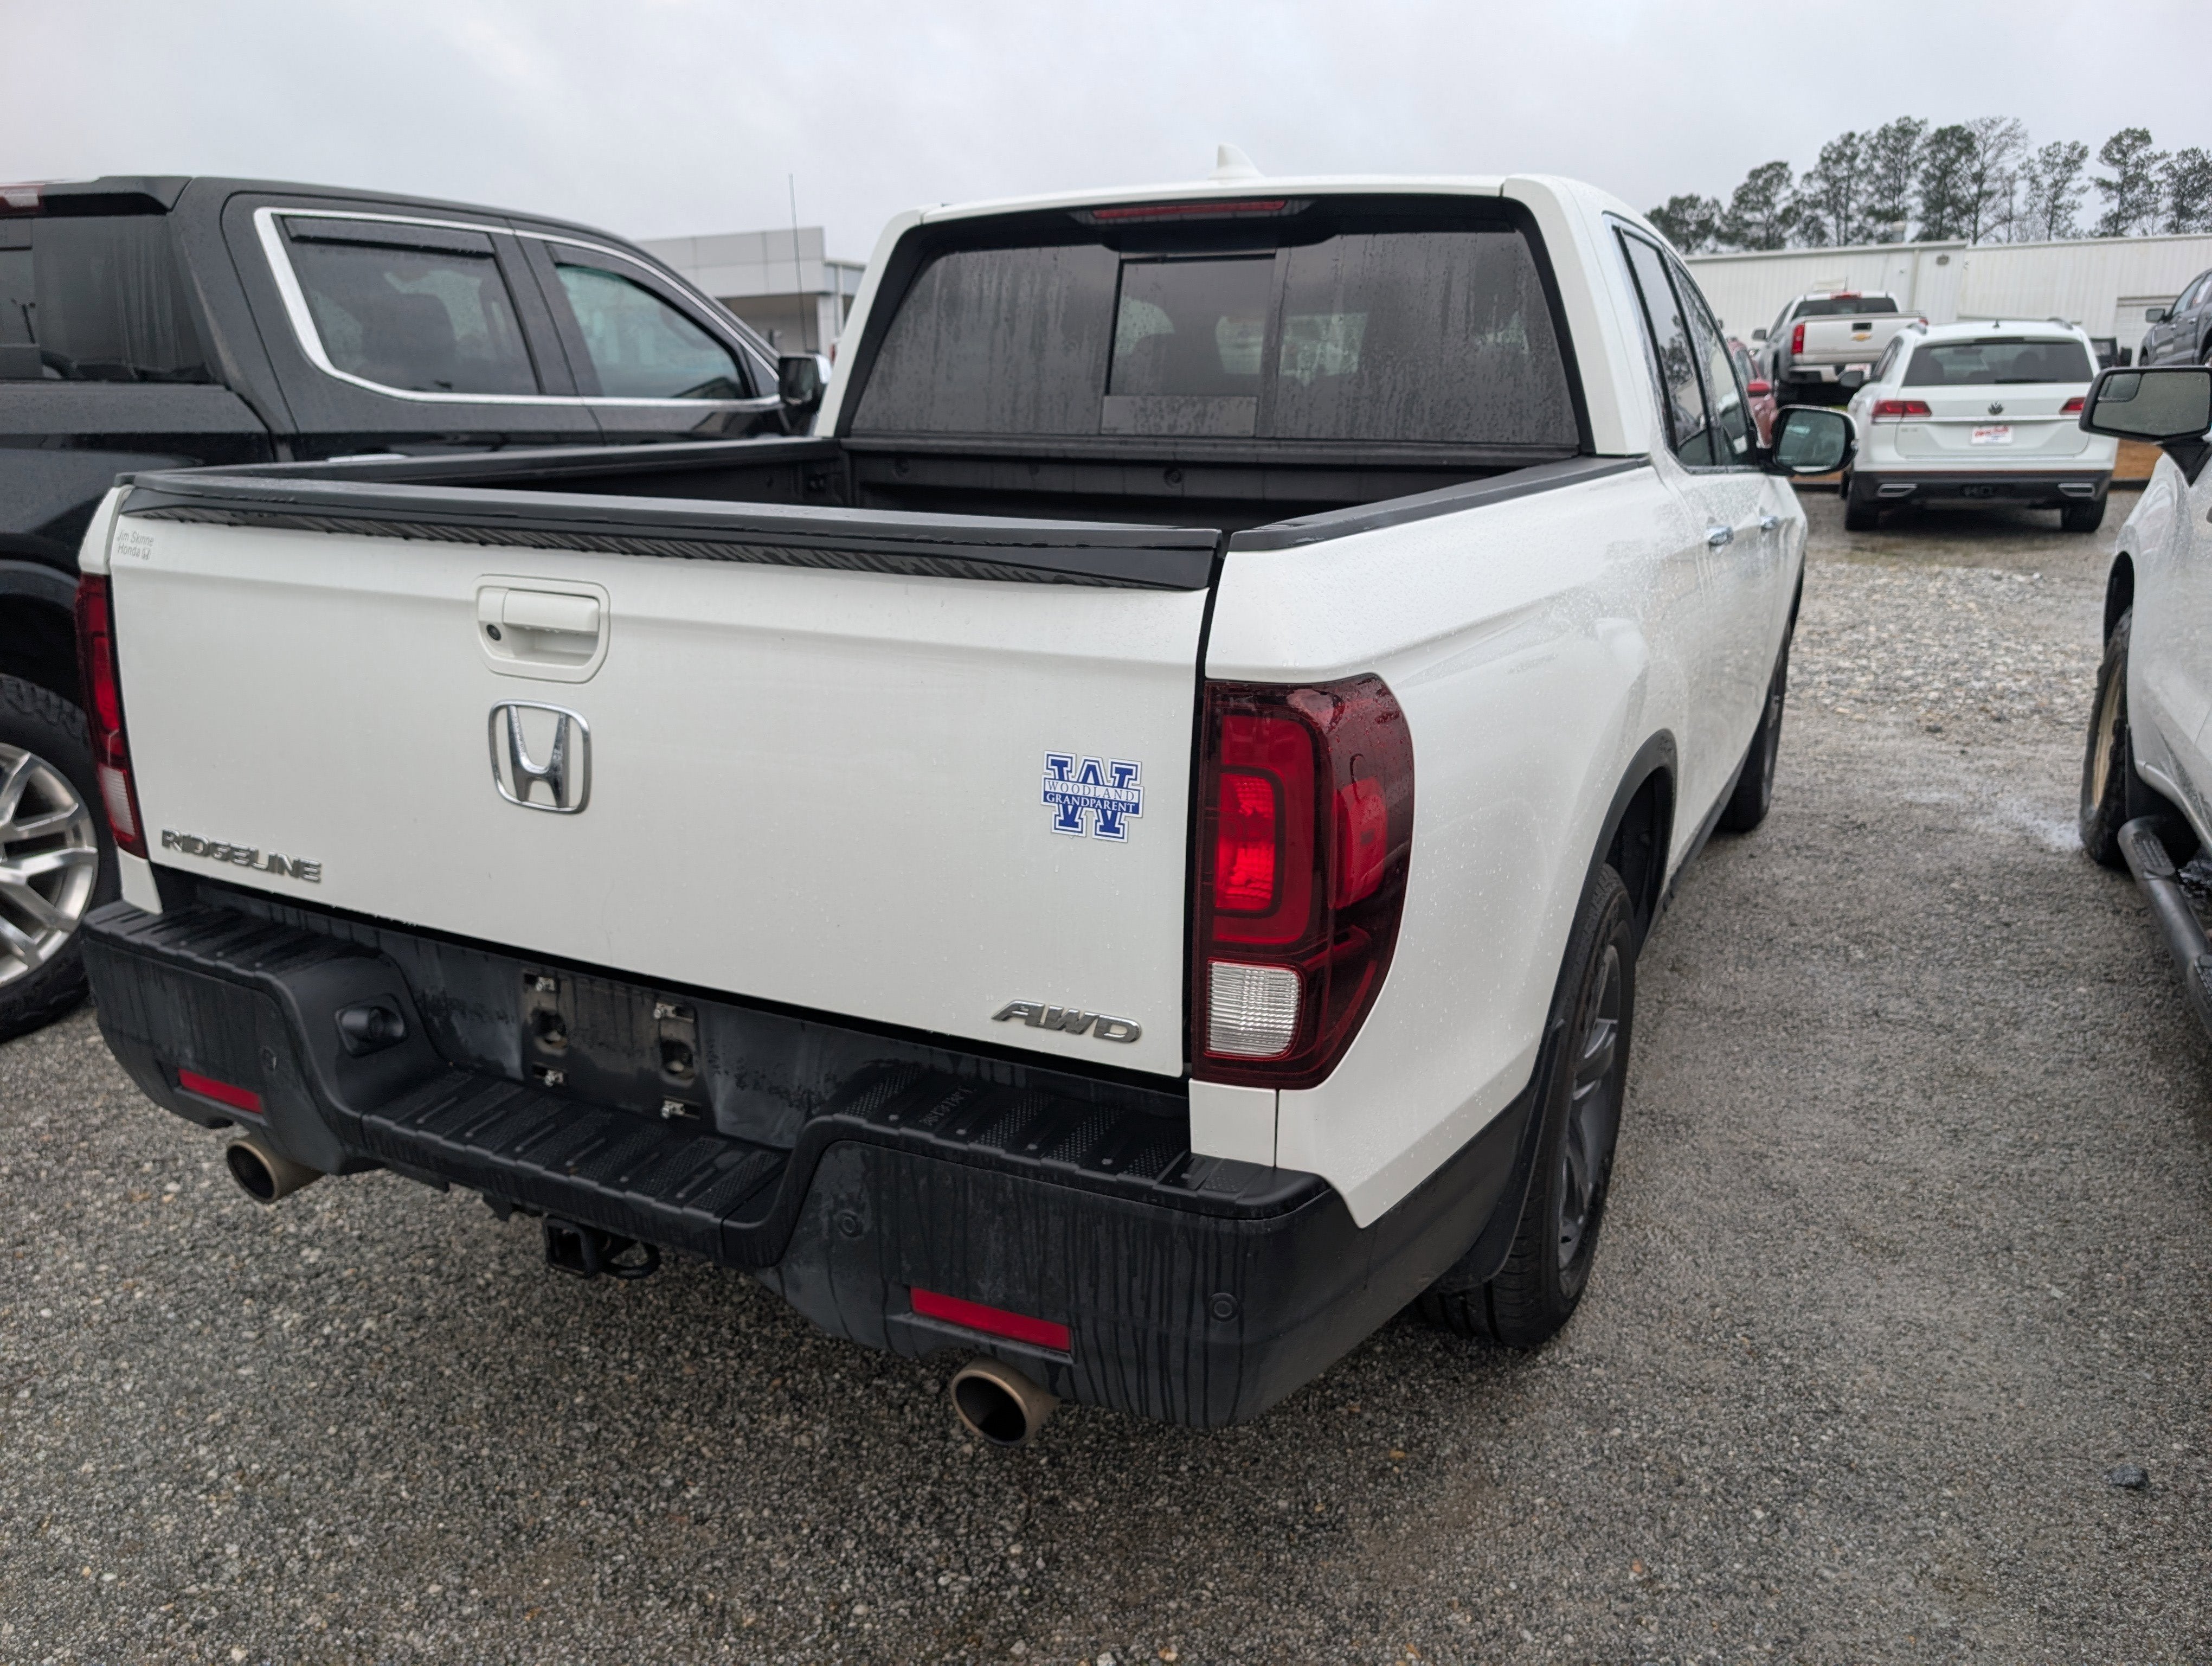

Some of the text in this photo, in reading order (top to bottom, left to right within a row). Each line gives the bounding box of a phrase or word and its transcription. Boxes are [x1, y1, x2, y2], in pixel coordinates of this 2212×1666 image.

[118, 542, 140, 558] Honda
[1047, 780, 1135, 802] WOODLAND
[1046, 793, 1136, 813] GRANDPARENT
[162, 828, 323, 884] RIDGELINE
[991, 999, 1142, 1044] AWD
